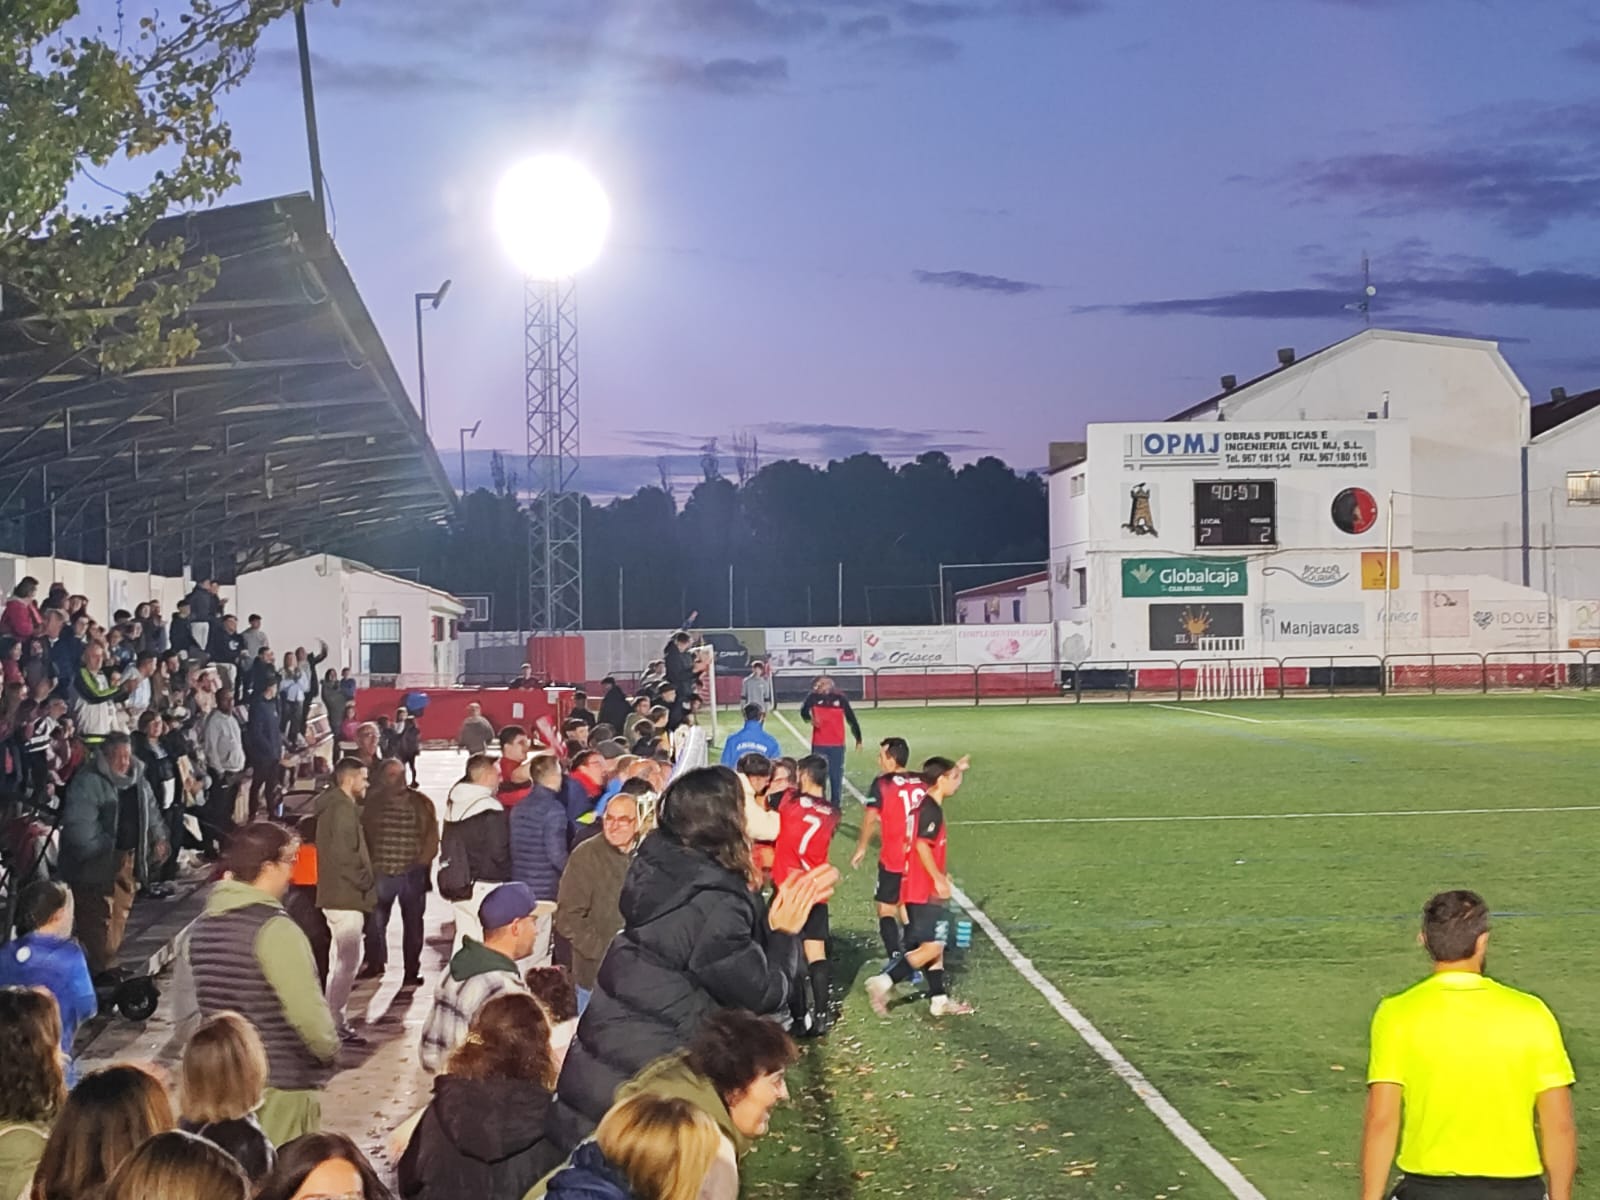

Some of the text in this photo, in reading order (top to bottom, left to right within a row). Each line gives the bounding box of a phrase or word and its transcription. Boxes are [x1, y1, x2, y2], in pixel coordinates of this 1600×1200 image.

[1224, 430, 1328, 440] OBRAS PUBLICAS E
[1144, 433, 1220, 454] OPMJ
[1225, 442, 1288, 451] INGENIERIA
[1291, 441, 1320, 450] CIVIL
[1343, 441, 1363, 450] S.L.
[1226, 454, 1240, 463] Tel.
[1242, 453, 1257, 462] 967
[1299, 453, 1317, 462] FAX.
[1319, 452, 1334, 462] 967
[1260, 526, 1271, 543] 2
[1160, 567, 1239, 588] Globalcaja
[1280, 621, 1360, 637] Manjavacas
[784, 630, 843, 643] El Recreo
[799, 814, 821, 854] 7
